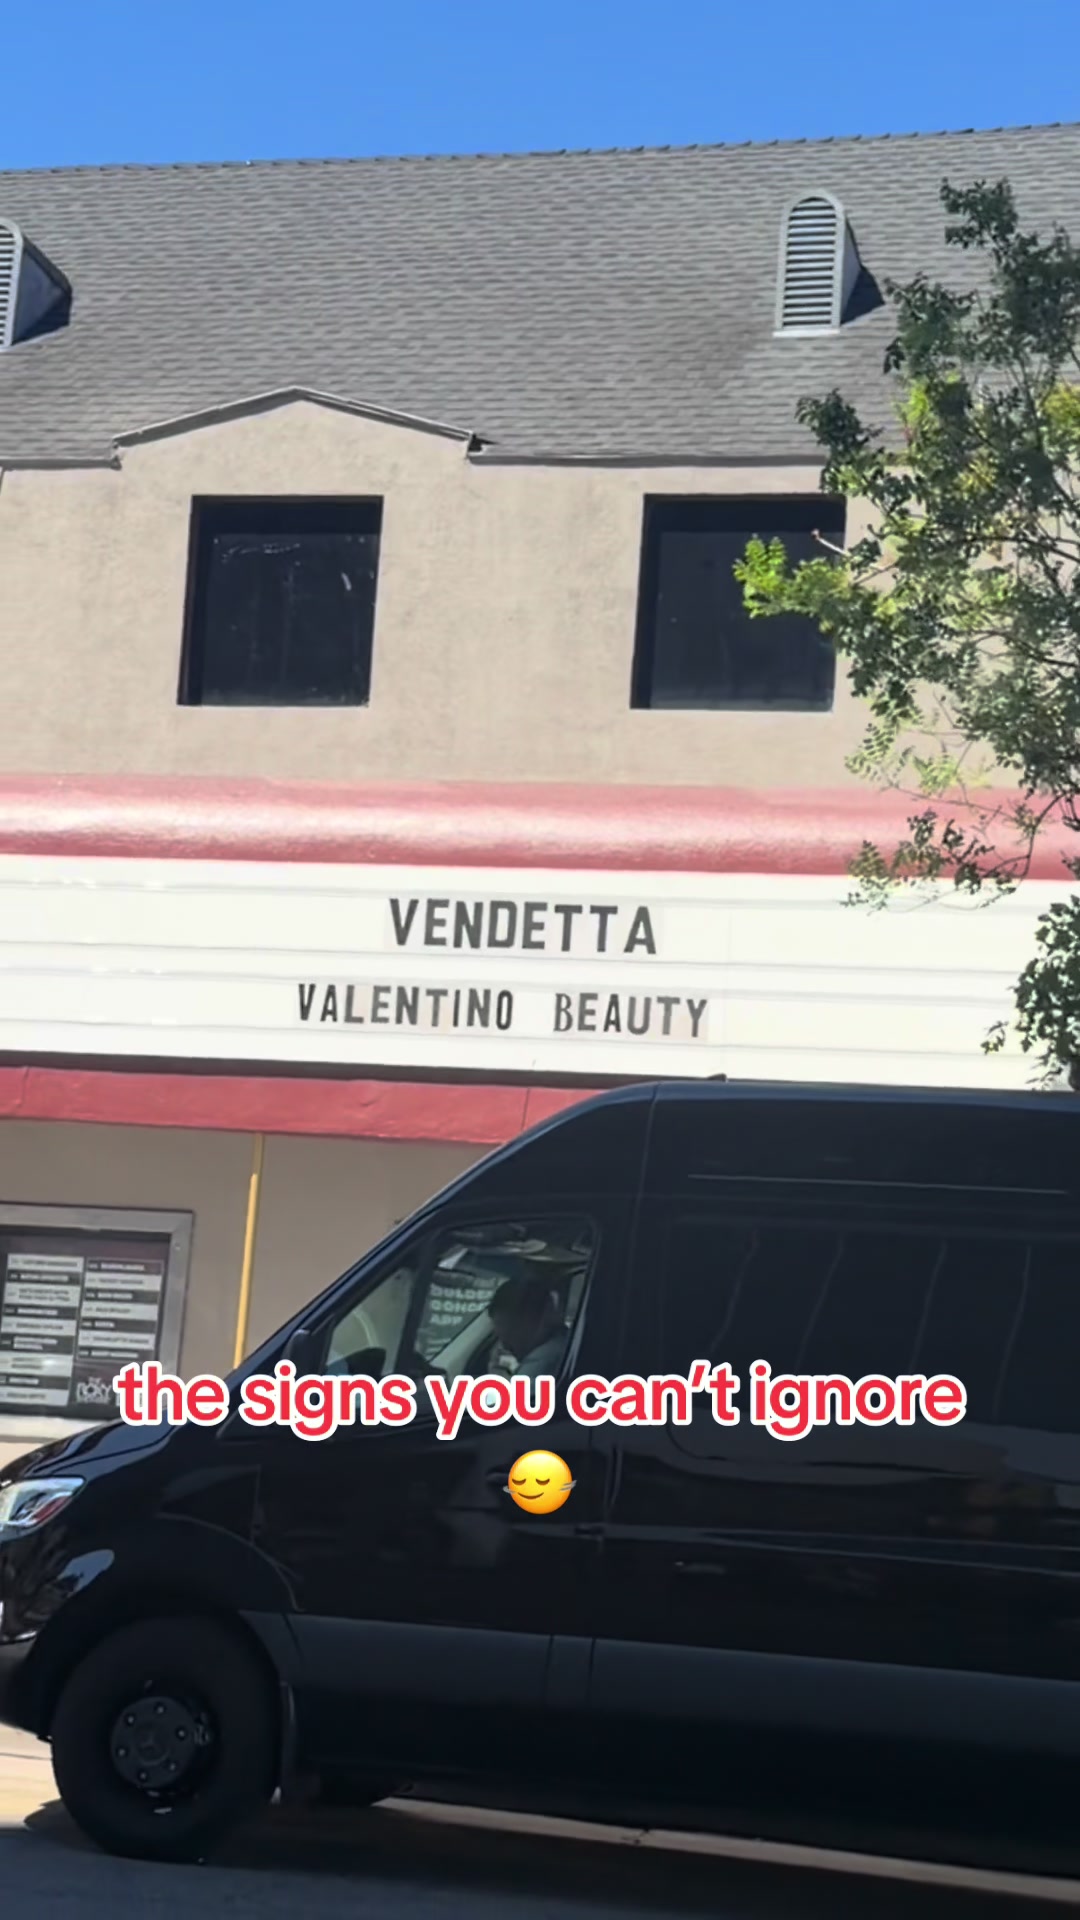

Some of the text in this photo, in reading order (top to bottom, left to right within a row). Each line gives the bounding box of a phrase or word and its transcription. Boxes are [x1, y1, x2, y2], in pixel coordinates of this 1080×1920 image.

[389, 898, 657, 955] VENDETTA
[298, 983, 708, 1038] VALENTINO BEAUTY
